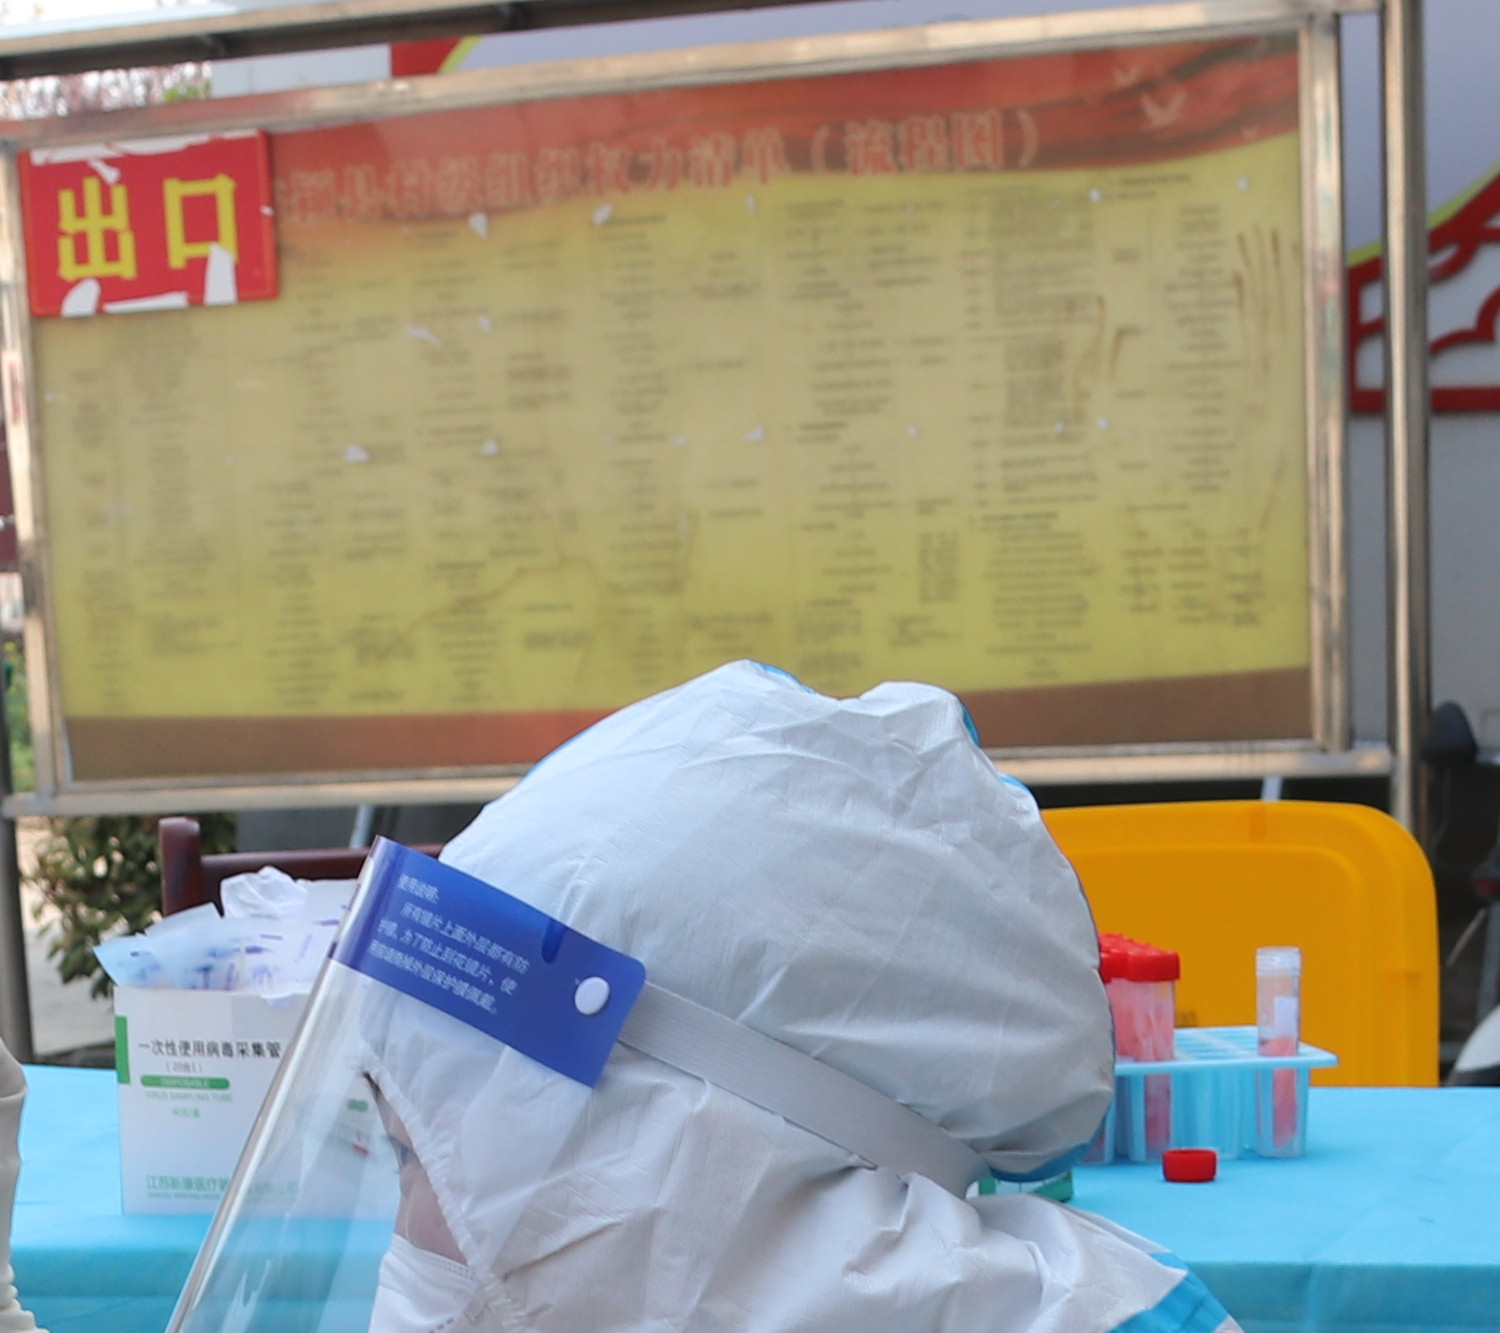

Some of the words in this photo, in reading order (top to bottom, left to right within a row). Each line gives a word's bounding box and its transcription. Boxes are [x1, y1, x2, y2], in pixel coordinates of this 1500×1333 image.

[57, 172, 239, 282] 出口
[138, 1039, 281, 1059] 一次性使用病毒采集管
